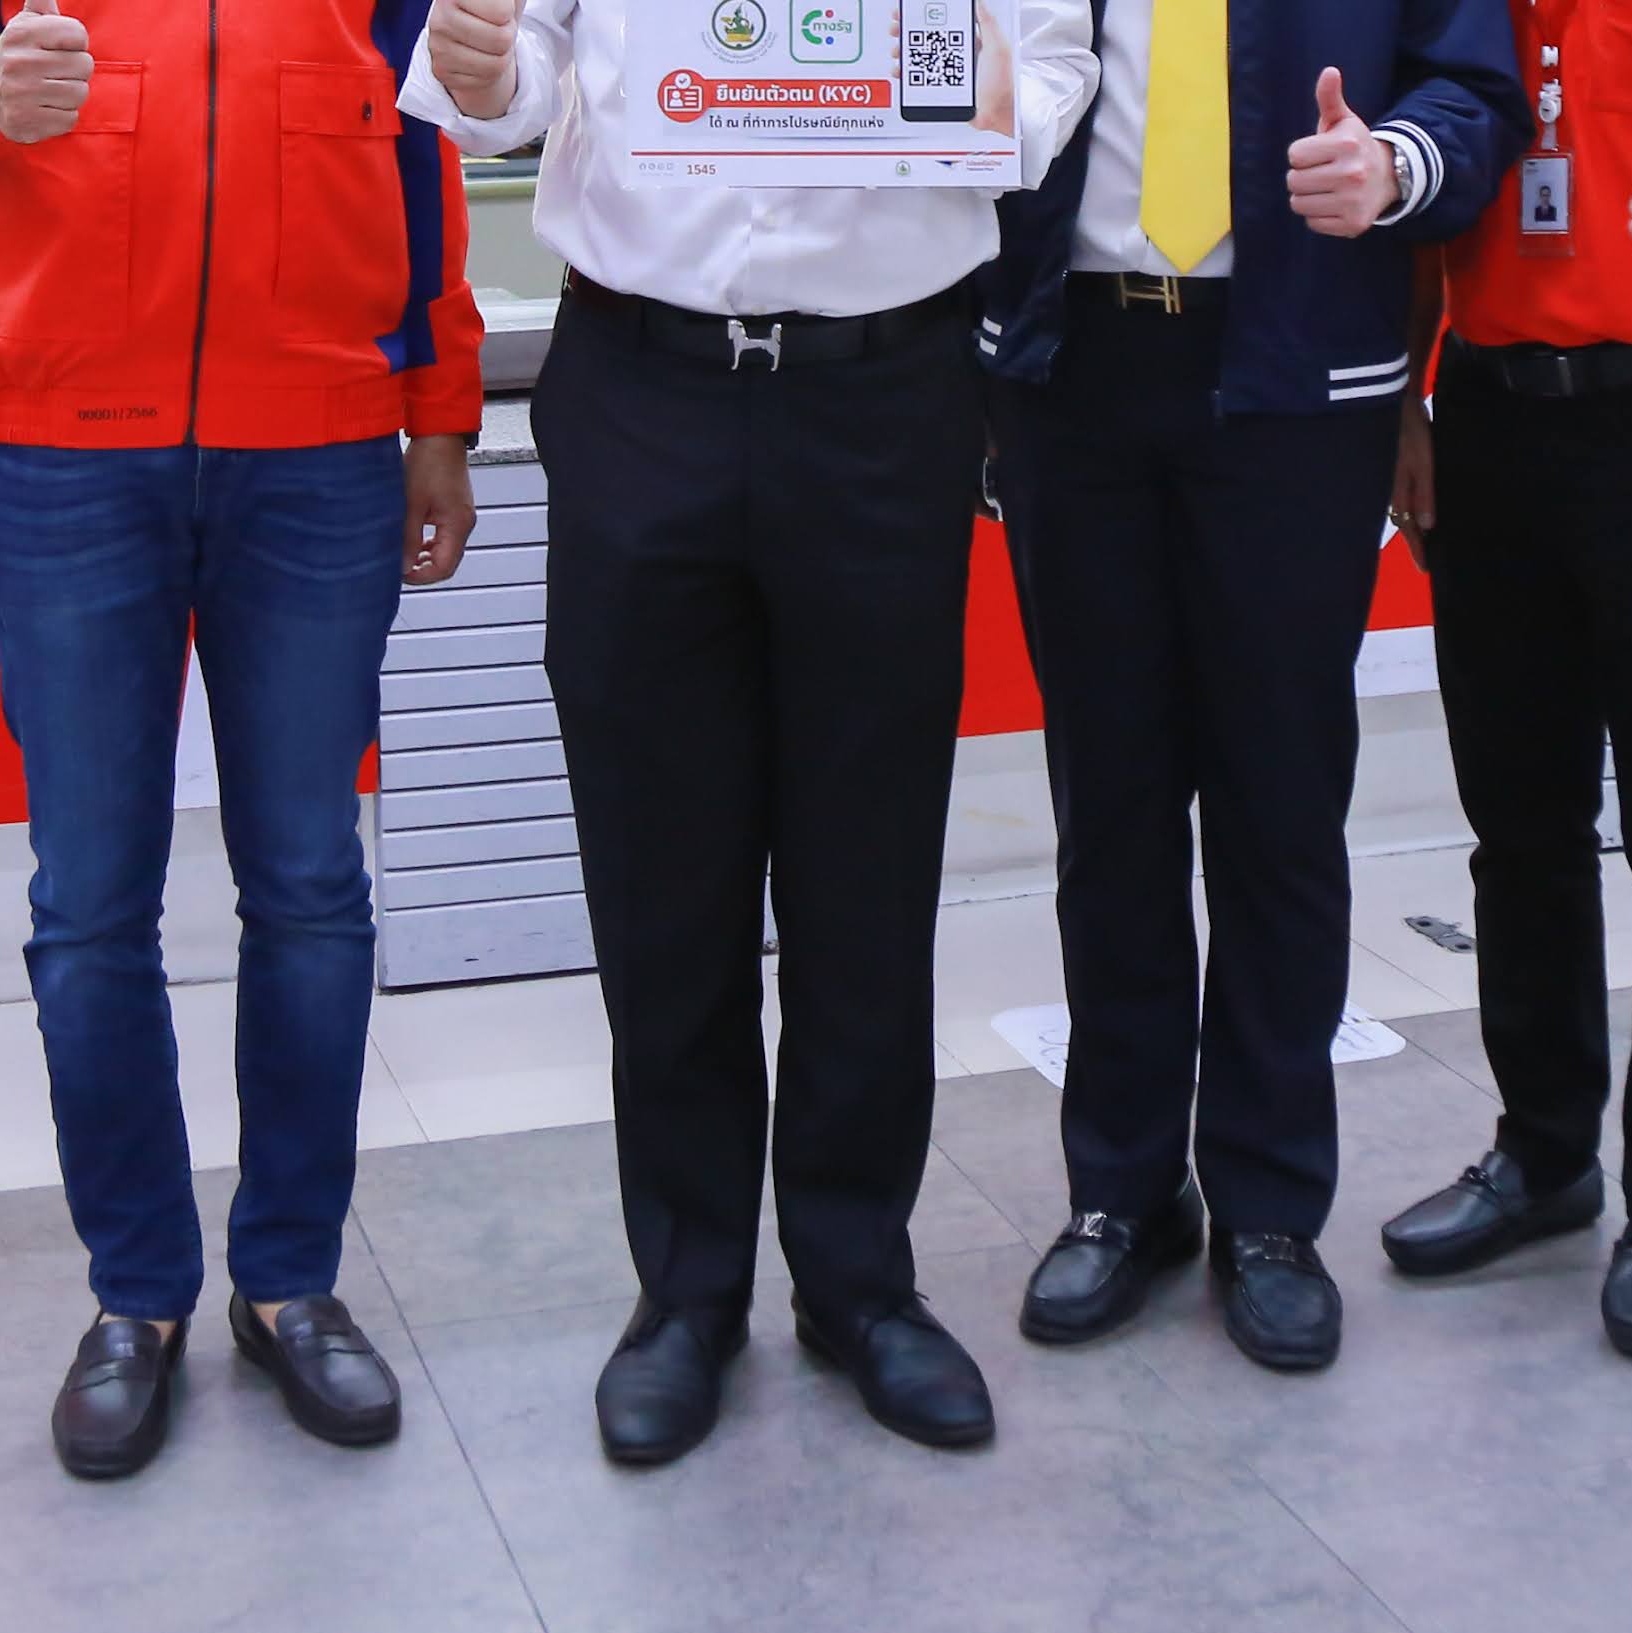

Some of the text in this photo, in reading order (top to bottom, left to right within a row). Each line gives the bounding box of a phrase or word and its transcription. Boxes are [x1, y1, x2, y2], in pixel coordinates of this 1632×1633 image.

[812, 19, 853, 34] ทางรัฐ
[715, 81, 872, 106] ยืนยันตัวตน (KYC)
[710, 114, 885, 132] ได้ ณ ที่ทำการไปรษณีย์ทุกแห่ง
[687, 163, 716, 175] 1545
